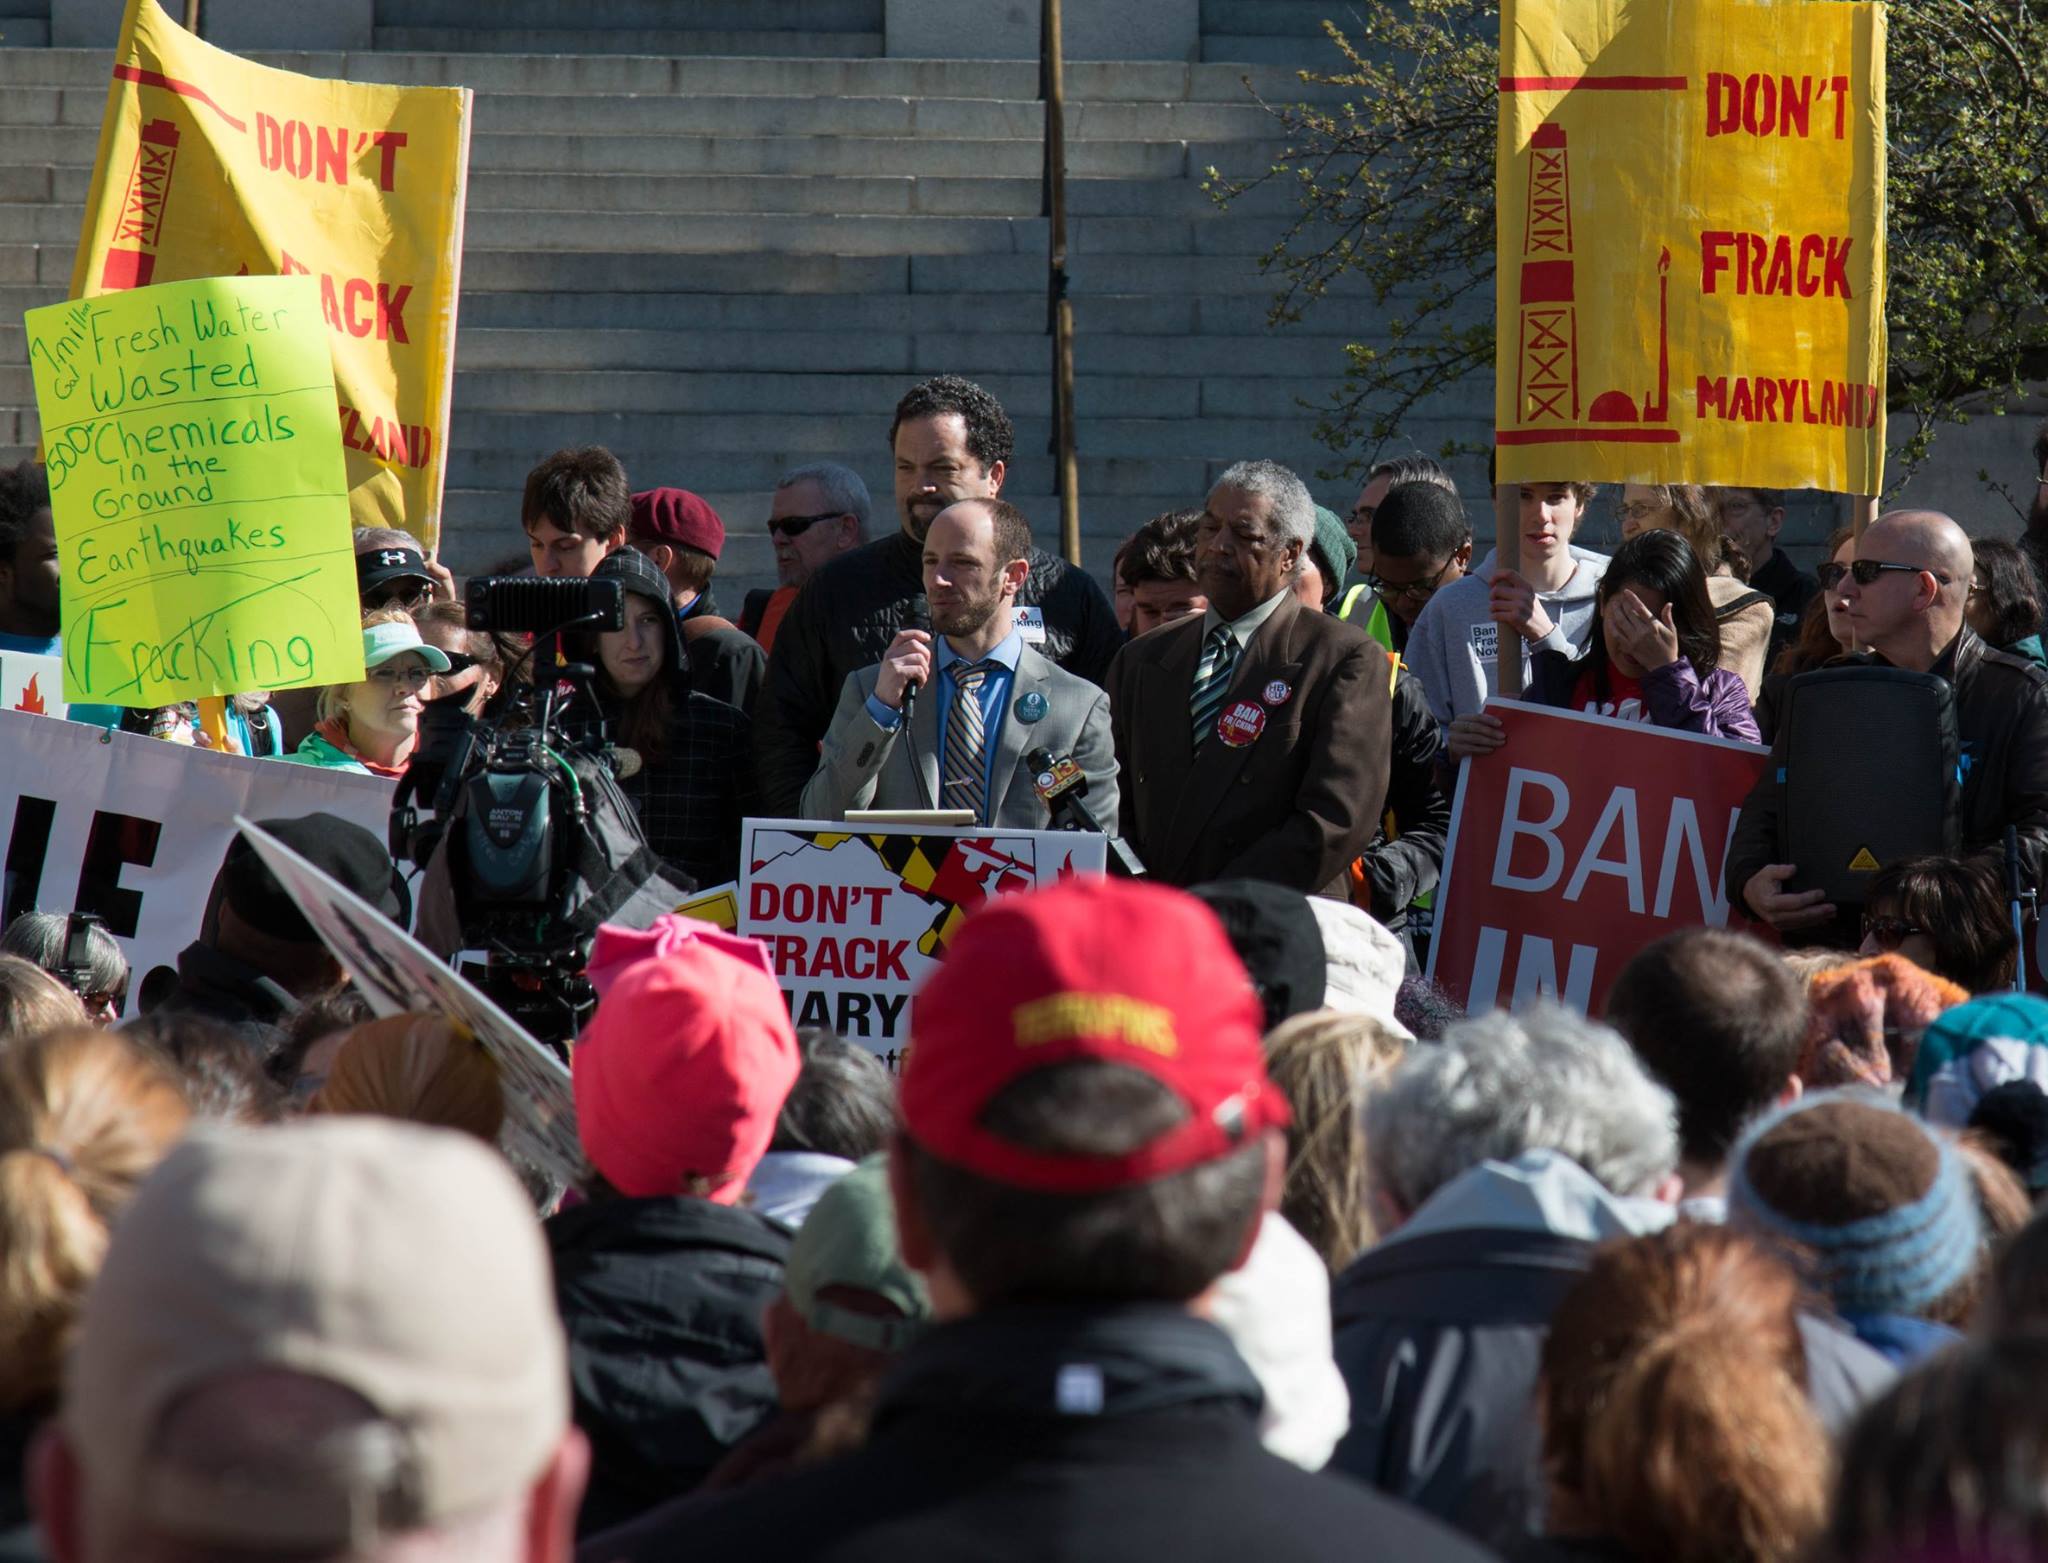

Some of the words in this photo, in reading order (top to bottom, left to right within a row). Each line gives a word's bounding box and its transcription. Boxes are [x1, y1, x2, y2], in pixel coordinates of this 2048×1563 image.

[1706, 73, 1849, 140] DON'T
[256, 111, 408, 193] DON'T
[1701, 230, 1854, 300] FRACK
[91, 305, 180, 365] Fresh
[192, 299, 288, 342] Water
[91, 344, 260, 413] Wasted
[1696, 375, 1878, 429] MARYLAND
[95, 403, 295, 466] Chemicals
[119, 460, 146, 483] in
[168, 454, 228, 479] the
[93, 484, 214, 519] Ground
[77, 517, 286, 584] Earthquakes
[85, 599, 314, 696] Fracking
[1012, 619, 1042, 629] king
[1472, 626, 1496, 637] Ban
[1232, 703, 1260, 723] BAN
[1050, 758, 1073, 781] 13
[1492, 767, 1742, 929] BAN
[750, 882, 893, 926] DON'T
[1466, 926, 1598, 1018] IN
[780, 990, 918, 1038] ARY
